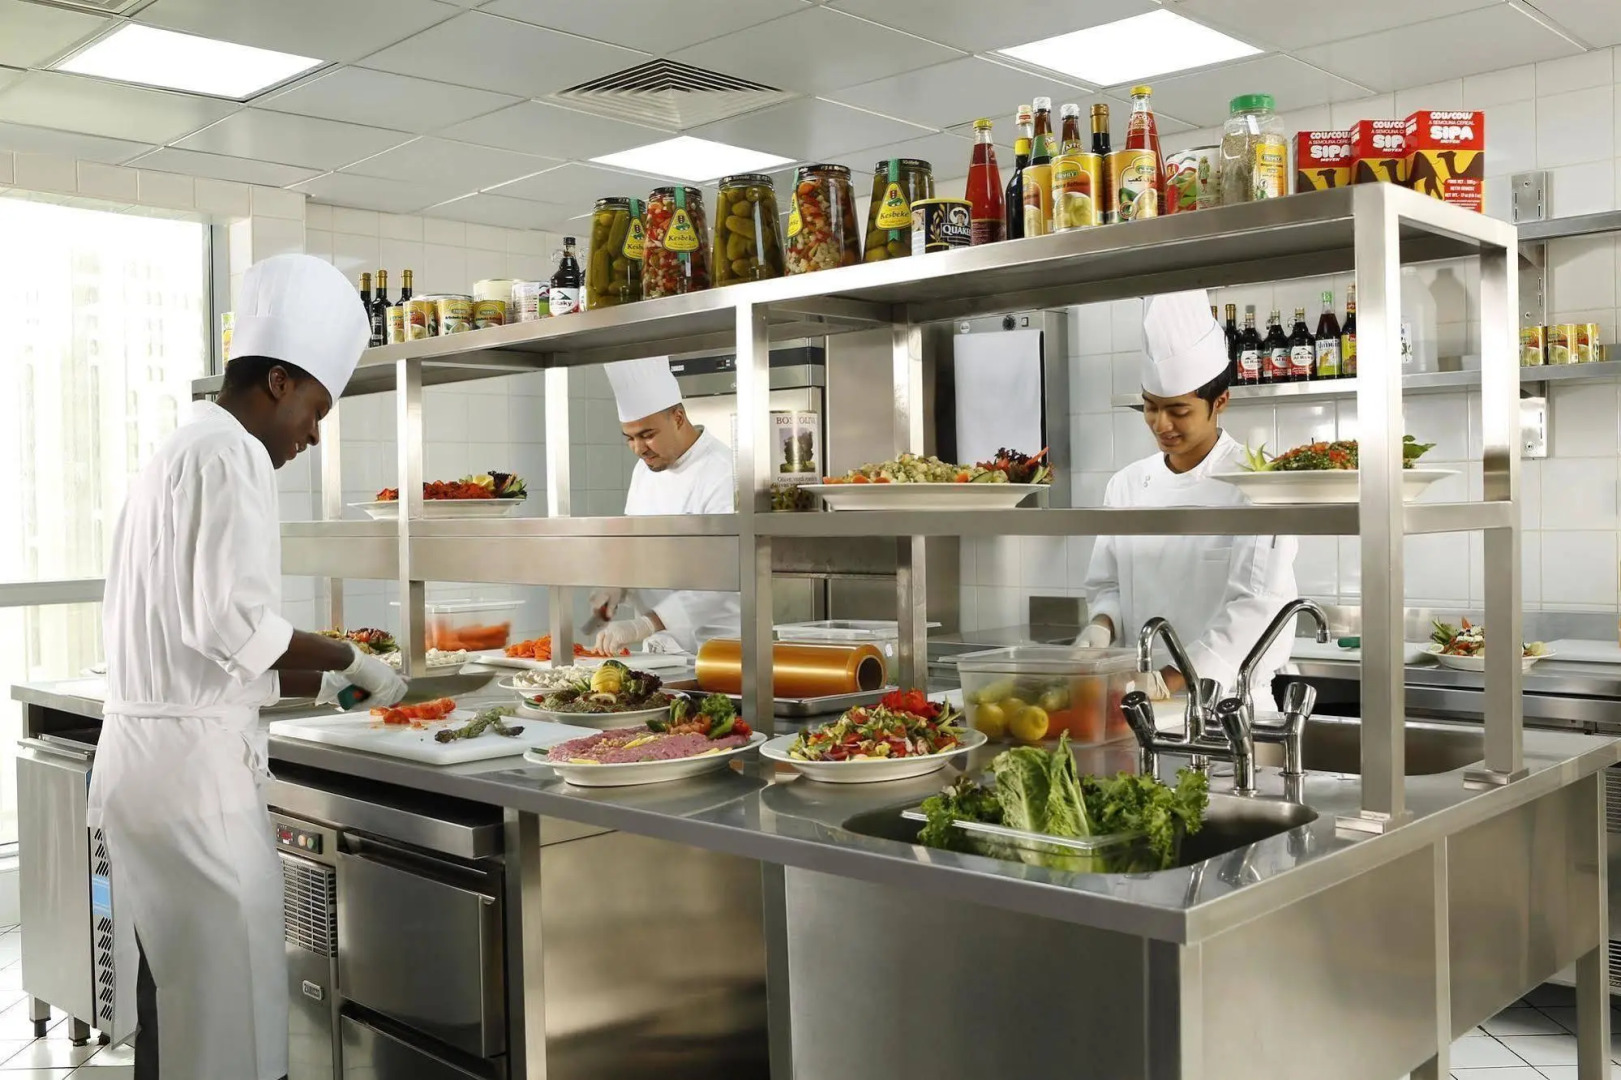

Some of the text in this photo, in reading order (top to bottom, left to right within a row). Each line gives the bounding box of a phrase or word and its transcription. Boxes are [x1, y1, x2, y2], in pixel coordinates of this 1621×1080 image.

[1430, 111, 1474, 120] COUSCOUS
[1372, 121, 1405, 129] COUSCO
[1430, 126, 1473, 140] SIPA
[1372, 134, 1406, 149] SIP
[1310, 144, 1351, 158] SIPA
[880, 211, 909, 219] Kesbeke
[942, 224, 971, 237] QUAKE
[668, 234, 696, 243] Kesbeke
[627, 243, 645, 251] Kesb
